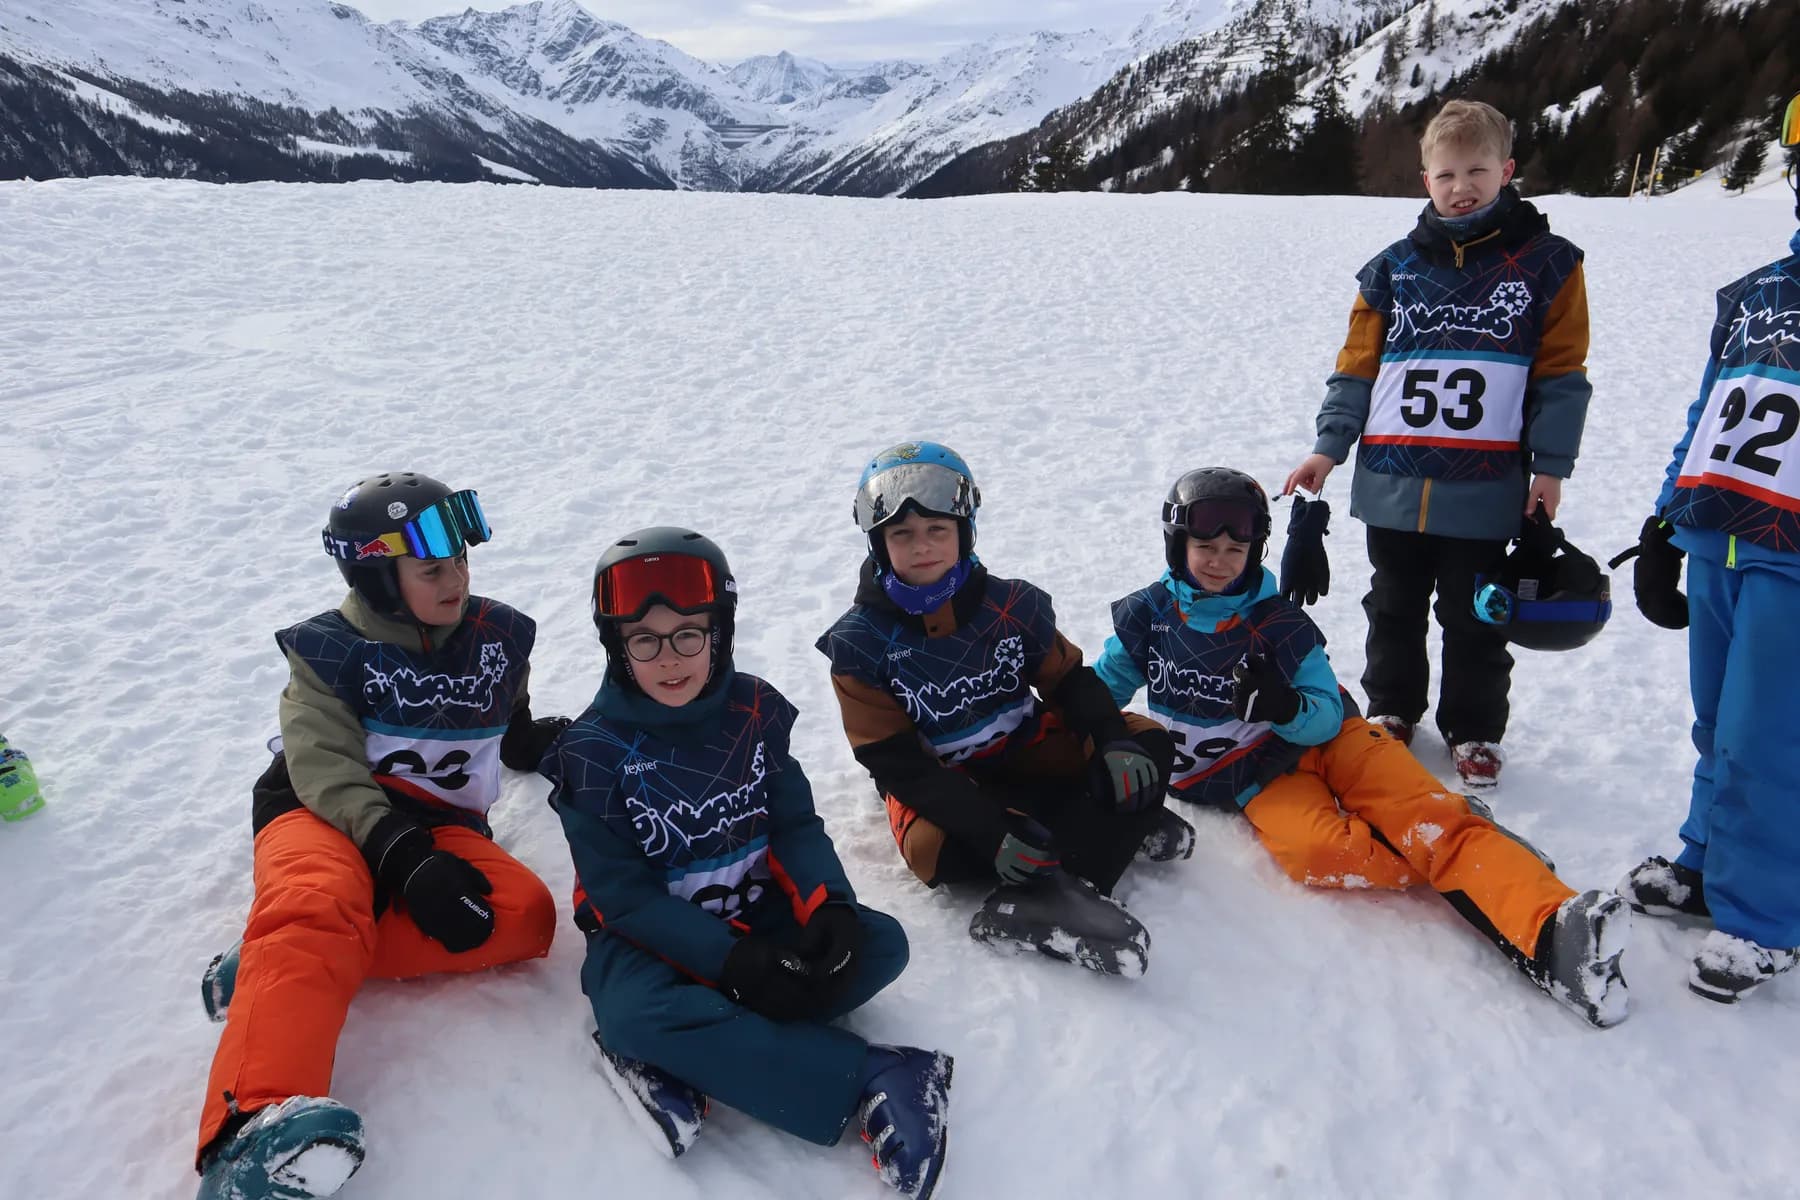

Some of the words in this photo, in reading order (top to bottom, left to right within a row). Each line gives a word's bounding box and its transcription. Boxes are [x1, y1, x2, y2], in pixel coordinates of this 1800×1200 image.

[1400, 368, 1487, 431] 53
[623, 759, 658, 776] texner
[459, 895, 490, 920] reusch
